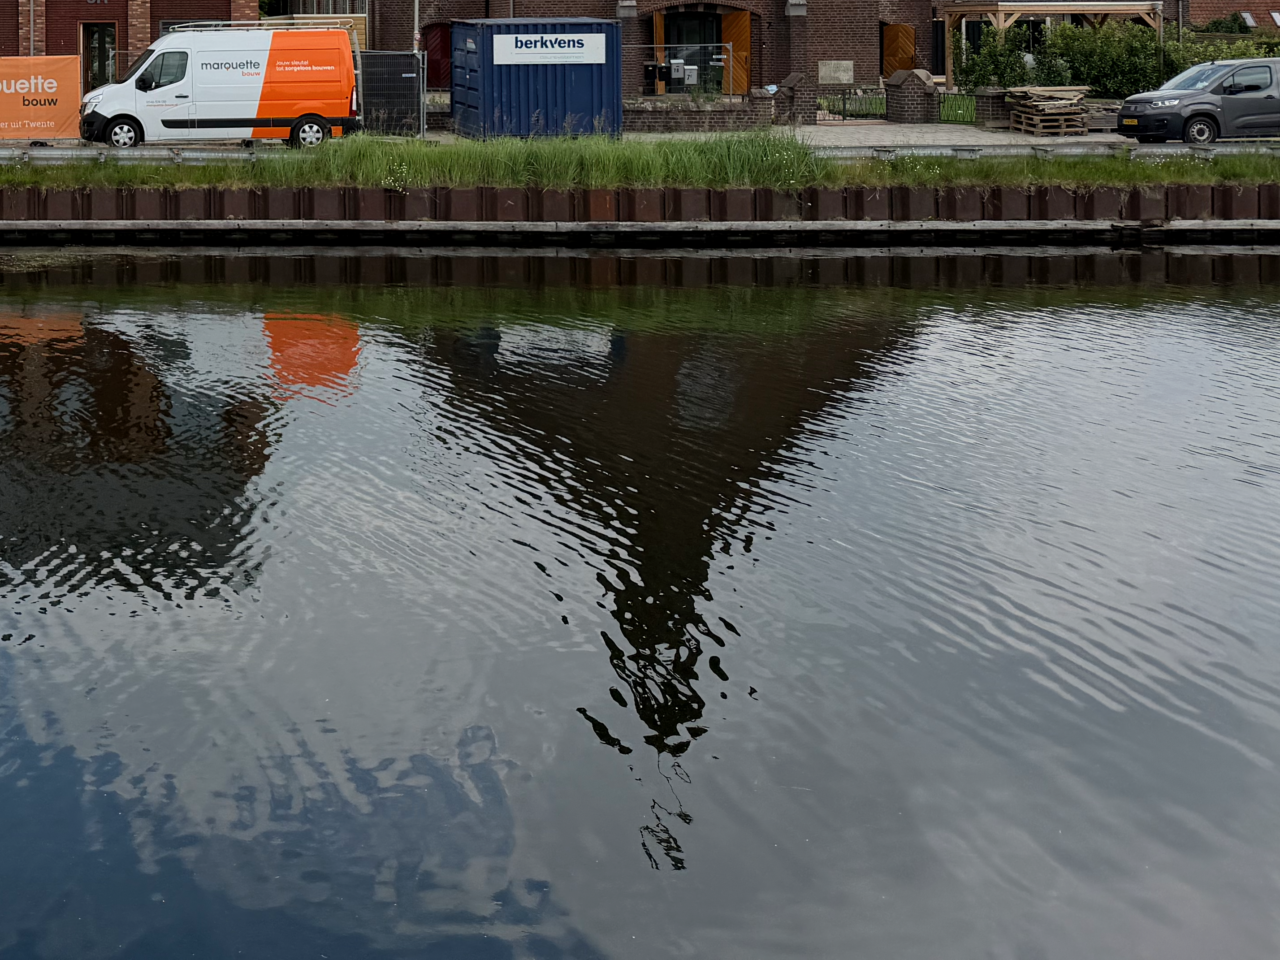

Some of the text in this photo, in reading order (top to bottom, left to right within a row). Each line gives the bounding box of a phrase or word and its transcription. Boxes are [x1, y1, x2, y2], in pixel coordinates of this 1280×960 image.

[514, 36, 585, 49] berkvens
[200, 60, 261, 72] marquette
[22, 96, 59, 107] bouw
[10, 120, 22, 128] uit
[23, 120, 55, 128] Twente
